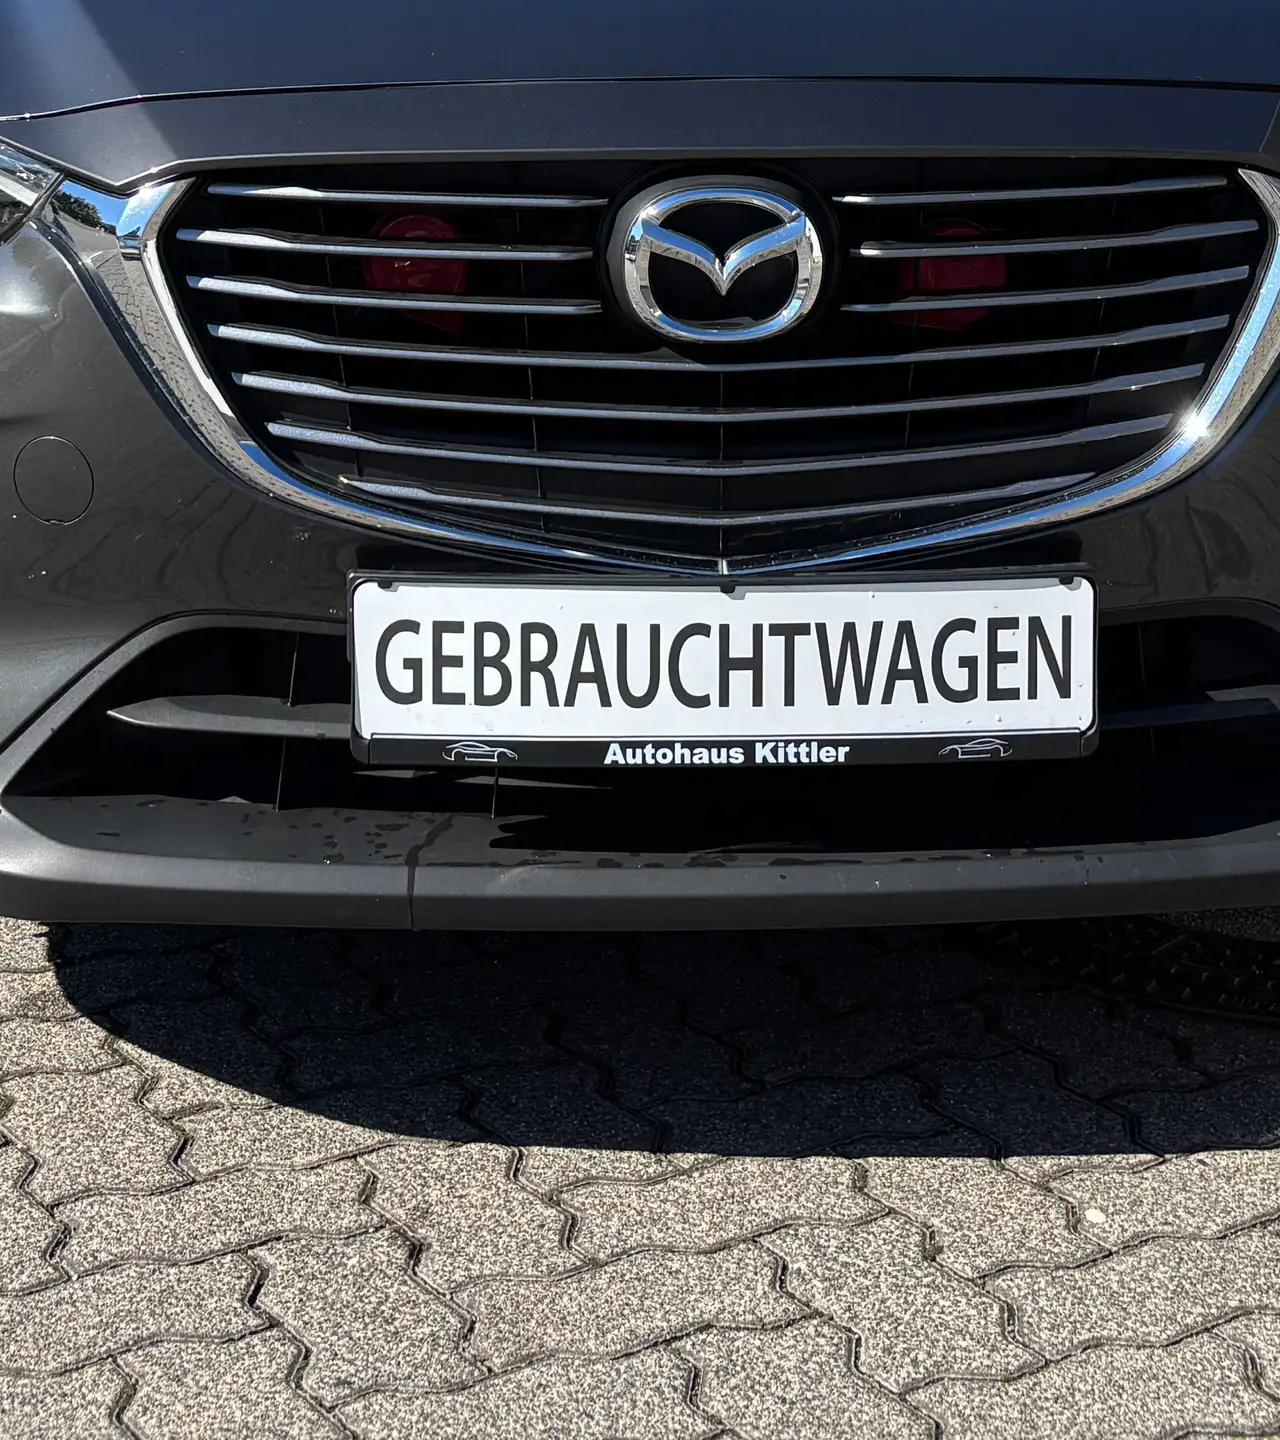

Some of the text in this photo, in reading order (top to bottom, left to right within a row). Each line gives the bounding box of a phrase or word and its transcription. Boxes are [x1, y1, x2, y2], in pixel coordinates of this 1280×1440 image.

[375, 615, 1072, 709] GEBRAUCHTWAGEN
[604, 741, 850, 765] Autohaus Kittler
